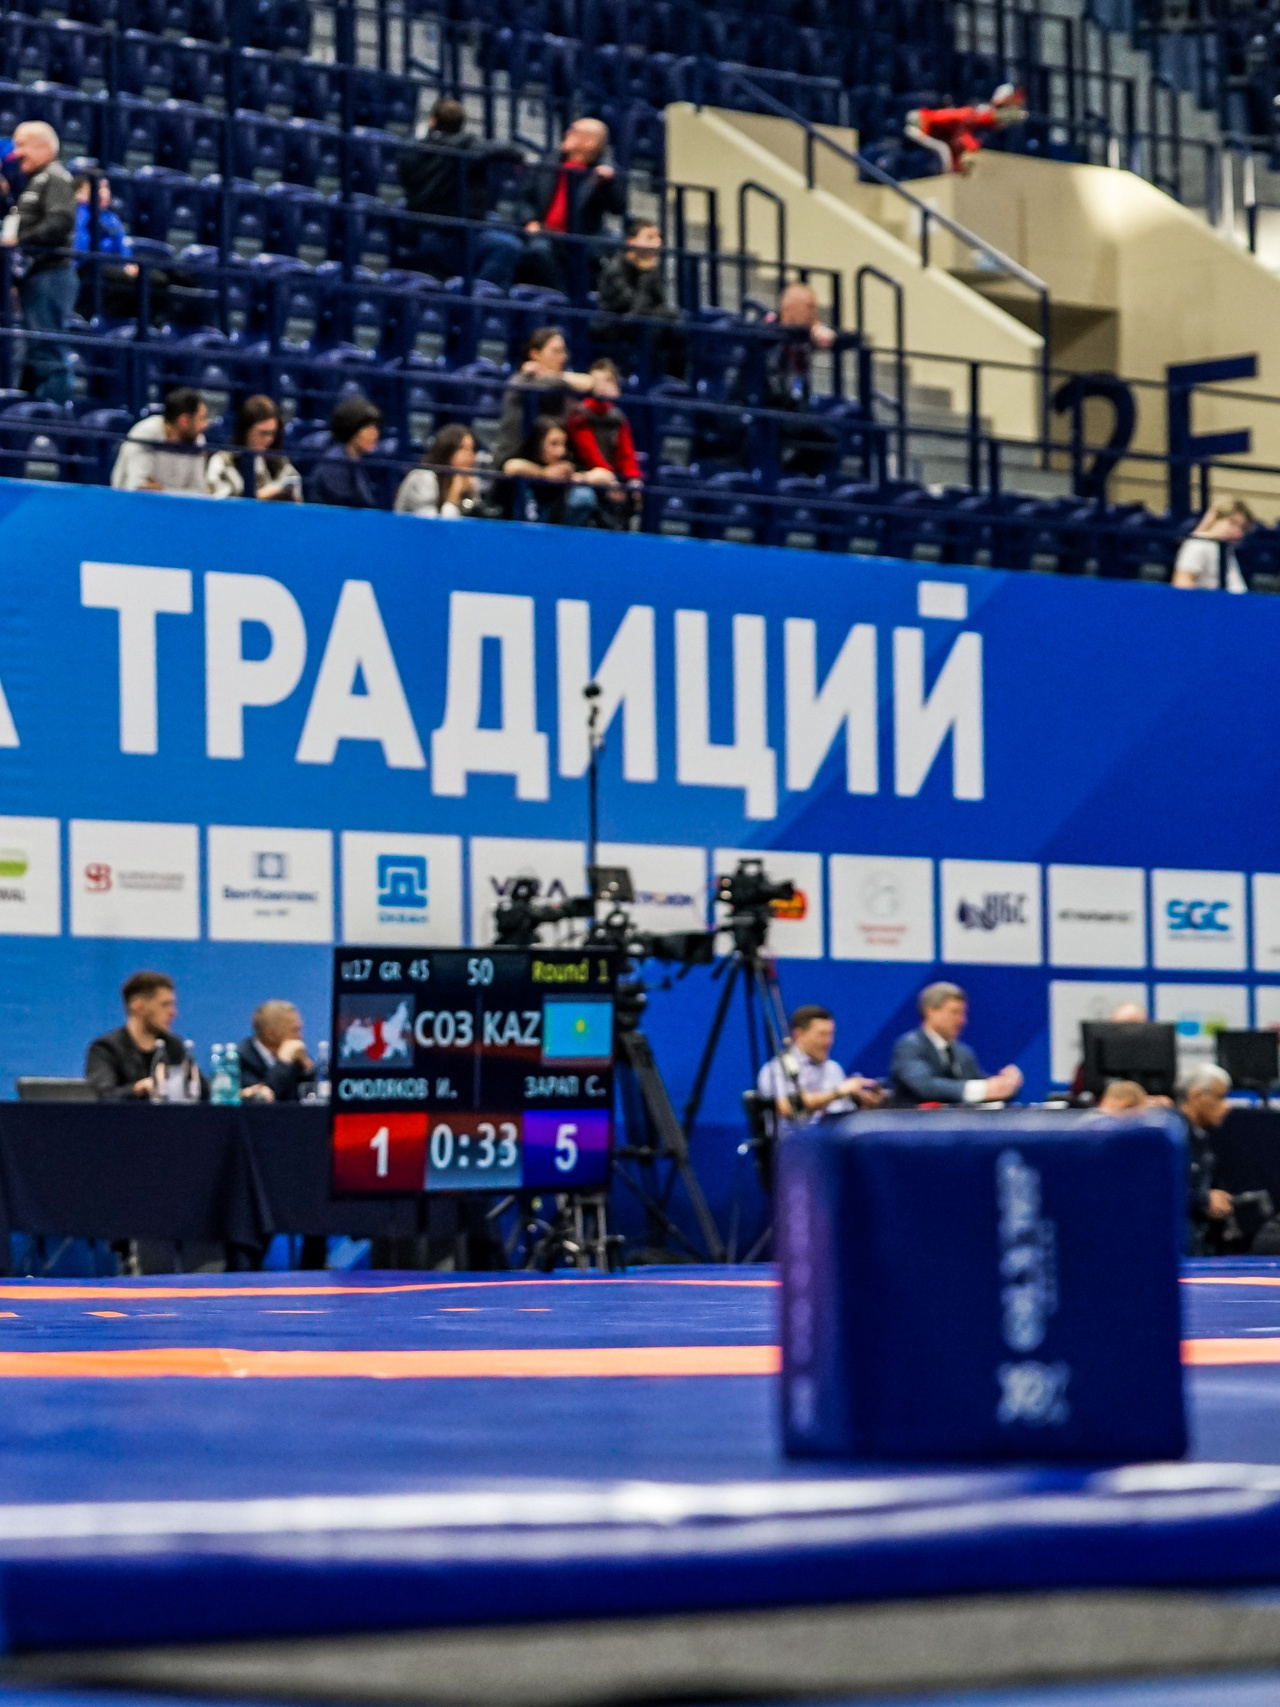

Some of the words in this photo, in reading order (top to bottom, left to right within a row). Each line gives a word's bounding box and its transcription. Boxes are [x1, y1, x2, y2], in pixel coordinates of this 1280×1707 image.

[80, 561, 984, 821] ТРАДИЦИЙ
[1166, 899, 1231, 931] SGC
[341, 959, 373, 982] U17
[407, 959, 431, 982] 45
[467, 957, 495, 986] 50
[532, 958, 589, 983] Round
[597, 959, 609, 983] 1
[482, 1010, 542, 1046] KAZ
[369, 1126, 390, 1178] 1
[430, 1122, 518, 1170] 0:33
[554, 1123, 579, 1173] 5
